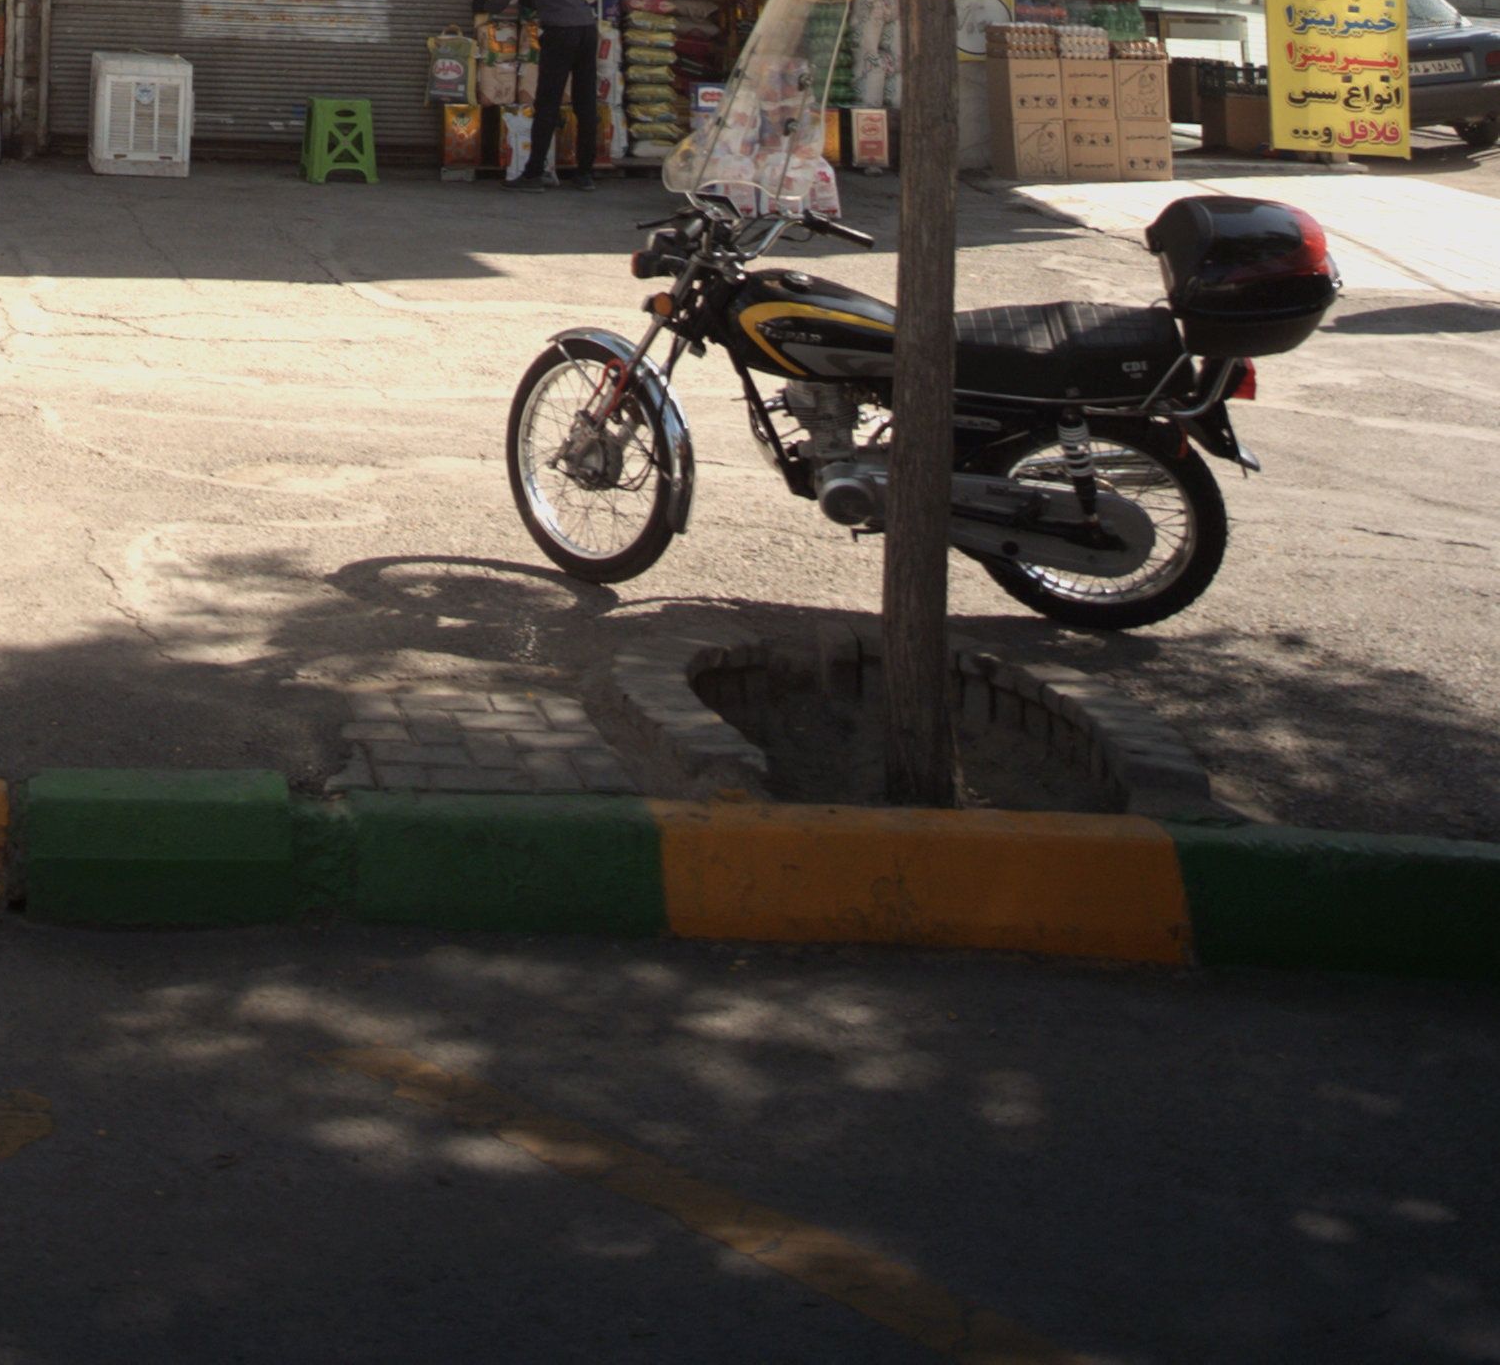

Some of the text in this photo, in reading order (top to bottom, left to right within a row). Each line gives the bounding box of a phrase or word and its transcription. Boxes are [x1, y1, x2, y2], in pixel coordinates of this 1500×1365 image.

[1286, 5, 1397, 37] خمیر پیتزا
[1286, 41, 1401, 77] پنیر پیتزا
[1288, 84, 1401, 110] انواع سس
[1338, 119, 1401, 145] فلافل
